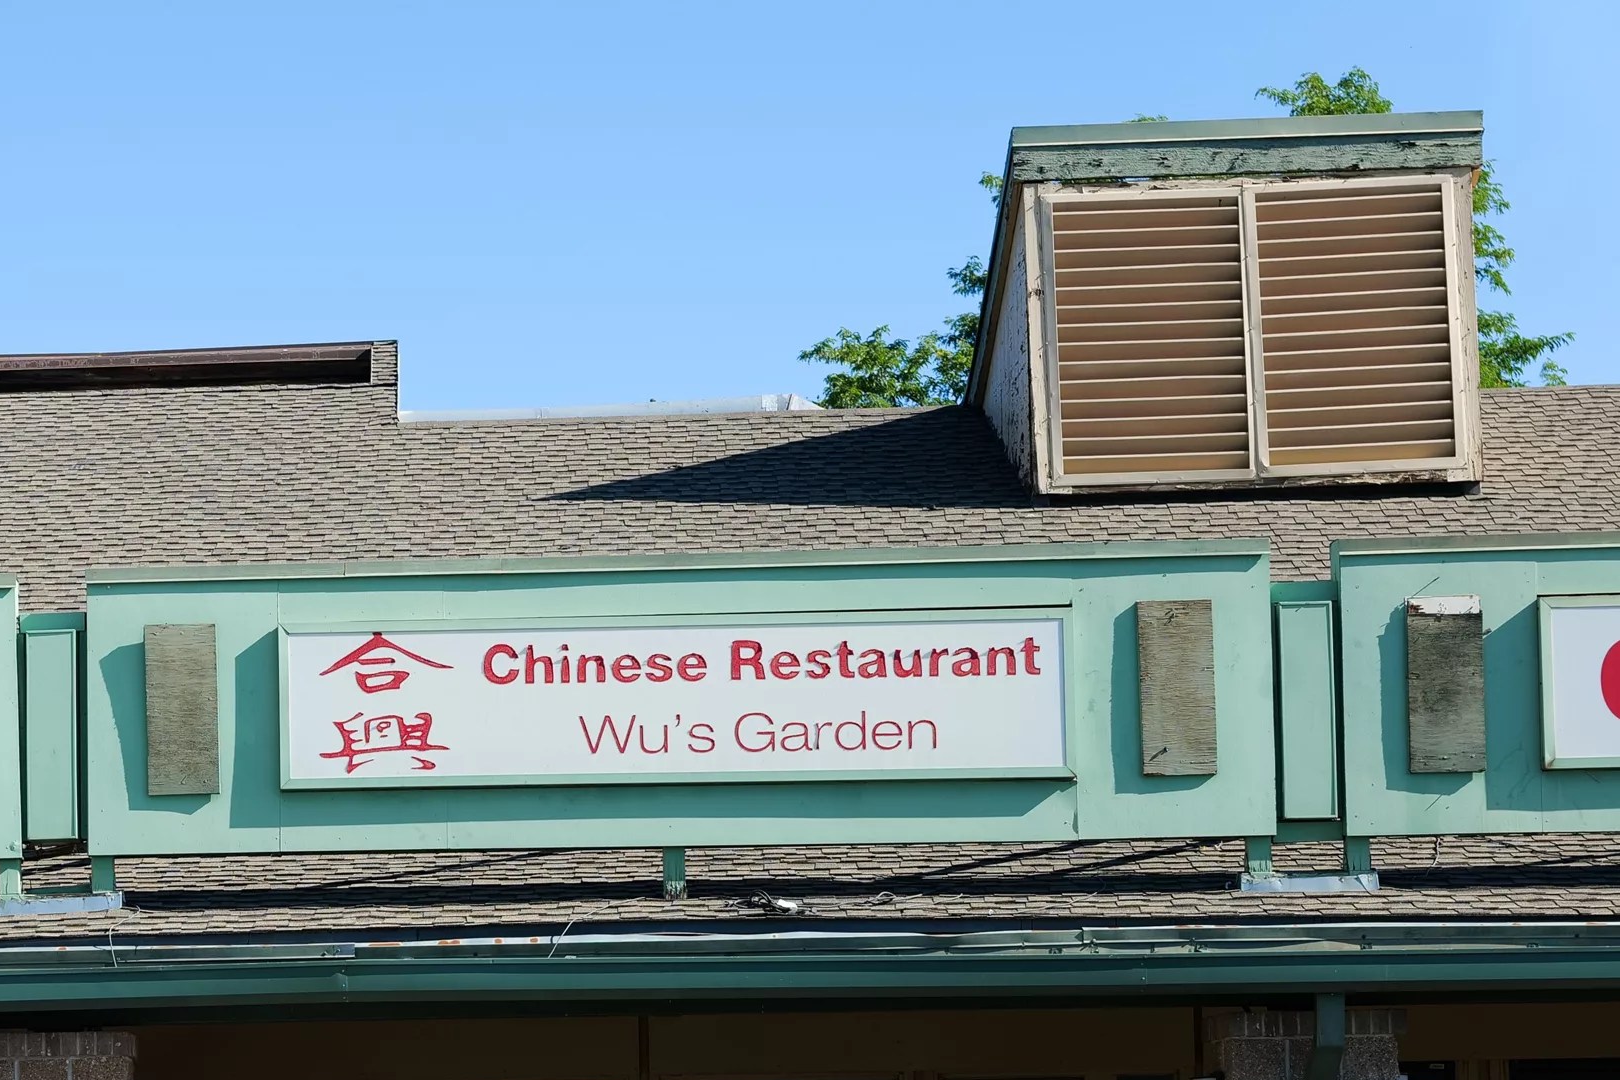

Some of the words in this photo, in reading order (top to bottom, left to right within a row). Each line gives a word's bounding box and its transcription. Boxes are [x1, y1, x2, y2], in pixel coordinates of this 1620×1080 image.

[483, 642, 708, 686] Chinese
[729, 636, 1042, 680] Restaurant
[579, 713, 716, 755] Wu's
[734, 710, 937, 752] Garden
